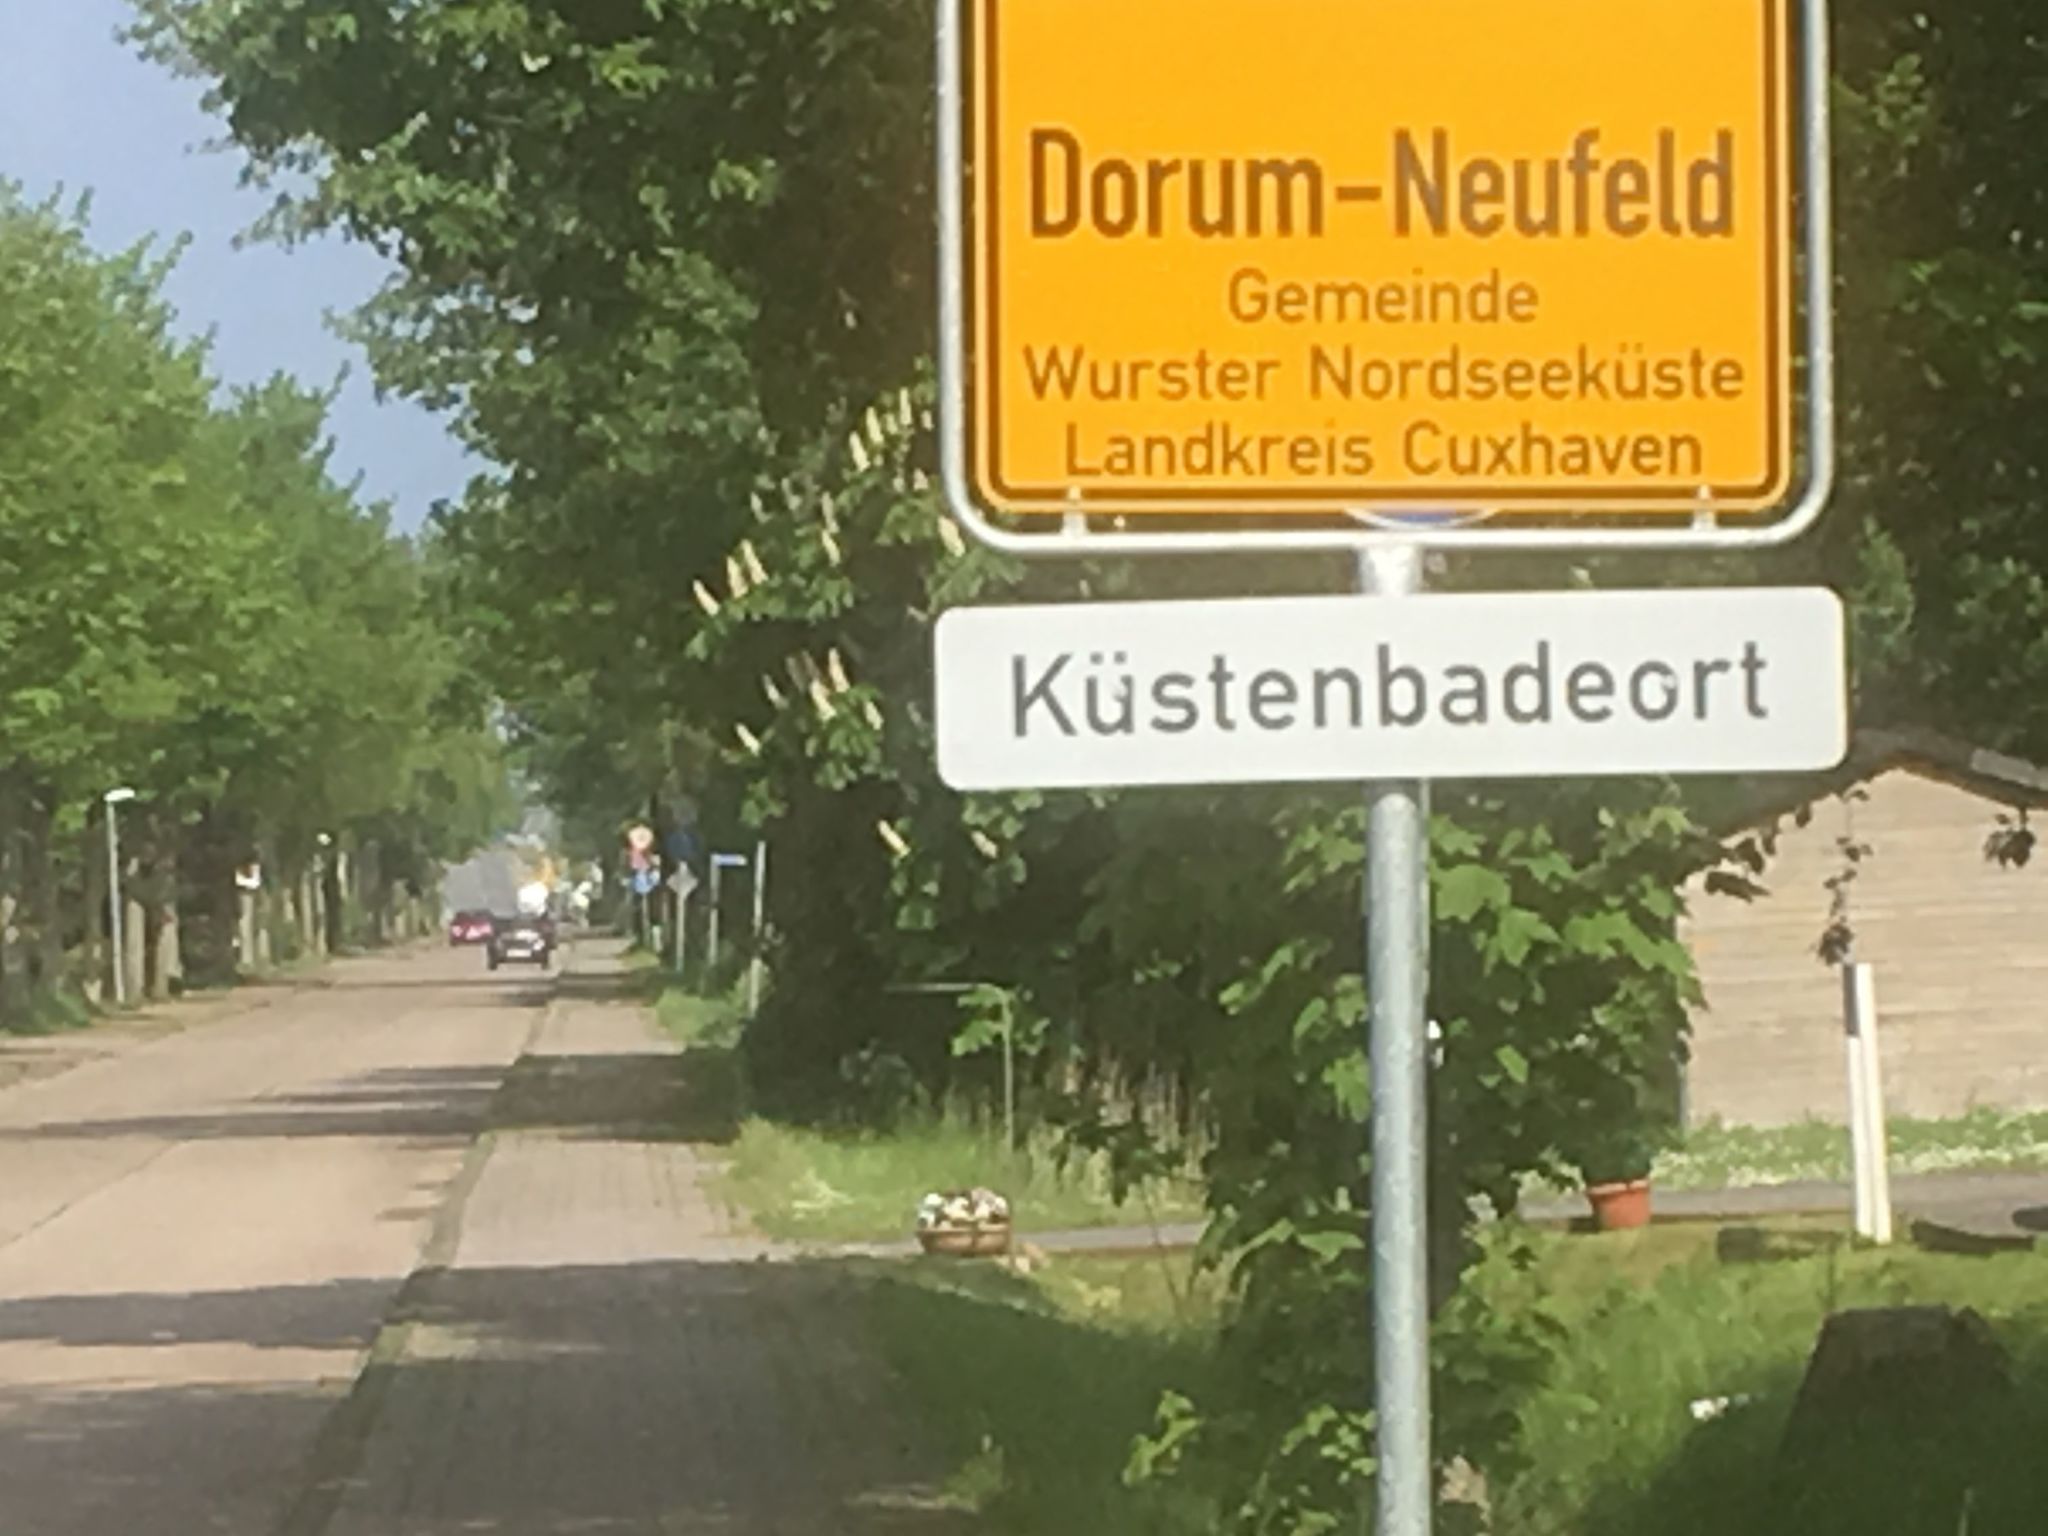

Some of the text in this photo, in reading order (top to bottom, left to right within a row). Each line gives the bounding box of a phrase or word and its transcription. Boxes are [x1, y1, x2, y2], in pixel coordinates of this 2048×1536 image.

[1029, 126, 1735, 240] Dorum-Neufeld
[1228, 267, 1540, 325] Gemeinde
[1022, 342, 1745, 402] Wurster Nordseeküste
[1065, 419, 1703, 478] Landkreis Cuxhaven
[1011, 640, 1769, 738] Küstenbadeort
